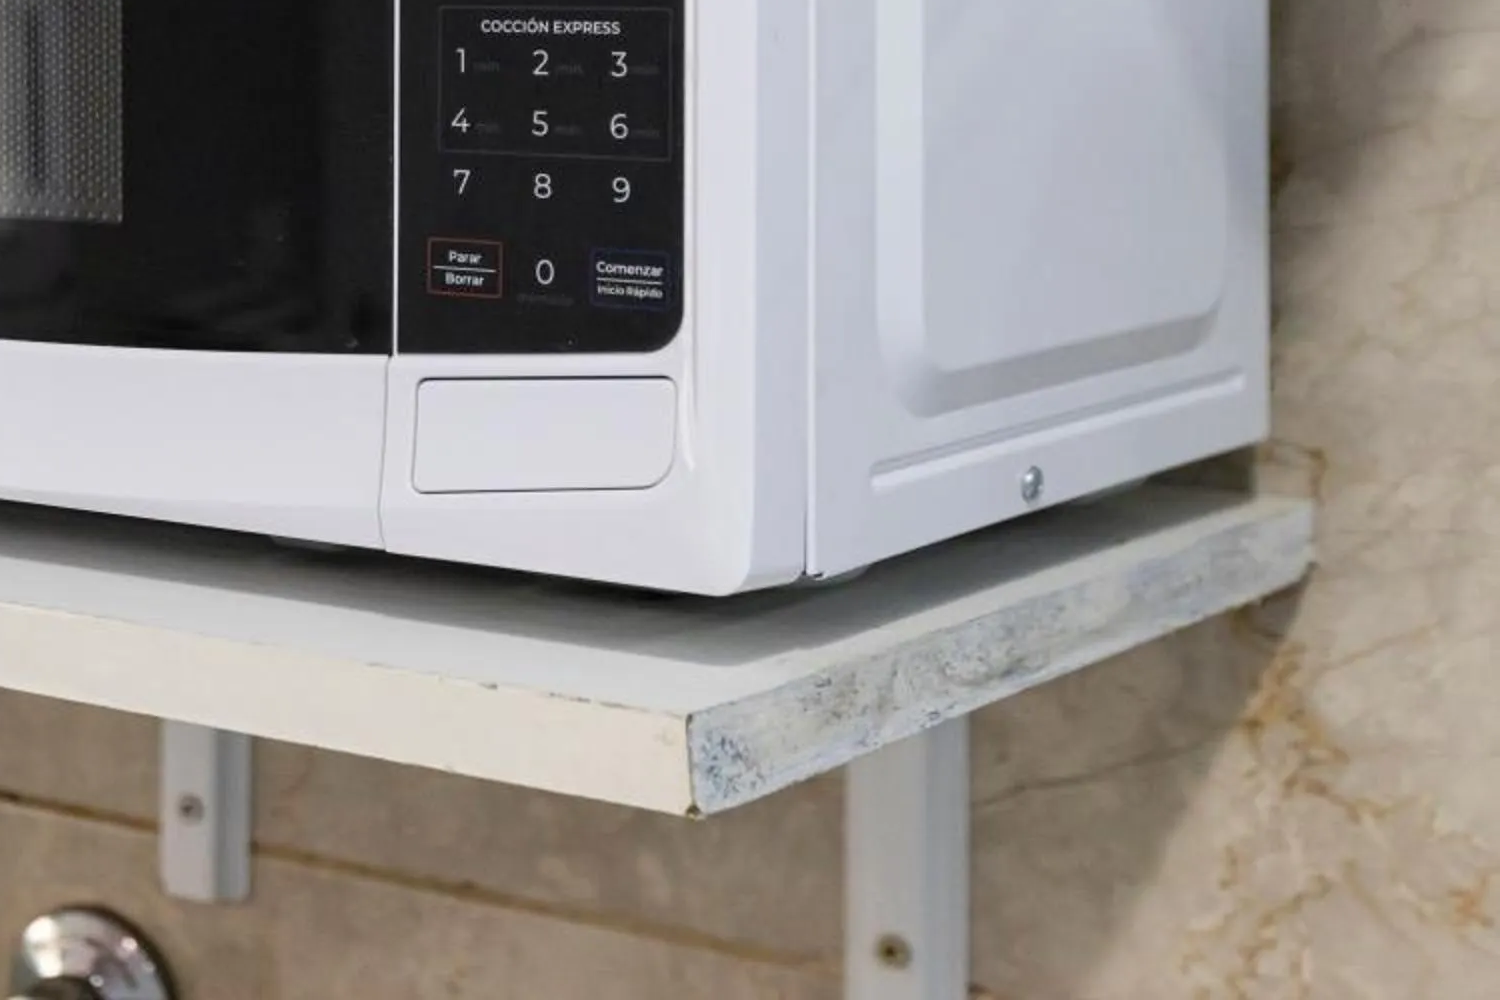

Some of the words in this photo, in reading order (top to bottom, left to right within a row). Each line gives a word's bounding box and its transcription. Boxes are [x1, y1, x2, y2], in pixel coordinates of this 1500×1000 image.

[480, 17, 549, 34] COCCIÓN
[553, 21, 621, 35] EXPRESS
[456, 48, 466, 73] 1
[532, 50, 549, 76] 2
[611, 51, 628, 77] 3
[451, 108, 471, 133] 4
[531, 111, 549, 136] 5
[610, 113, 629, 139] 6
[453, 169, 471, 195] 7
[533, 173, 552, 199] 8
[612, 177, 631, 203] 9
[448, 251, 482, 264] Parar
[596, 261, 664, 277] Comenzar
[445, 273, 484, 287] Borrar
[536, 259, 555, 285] 0
